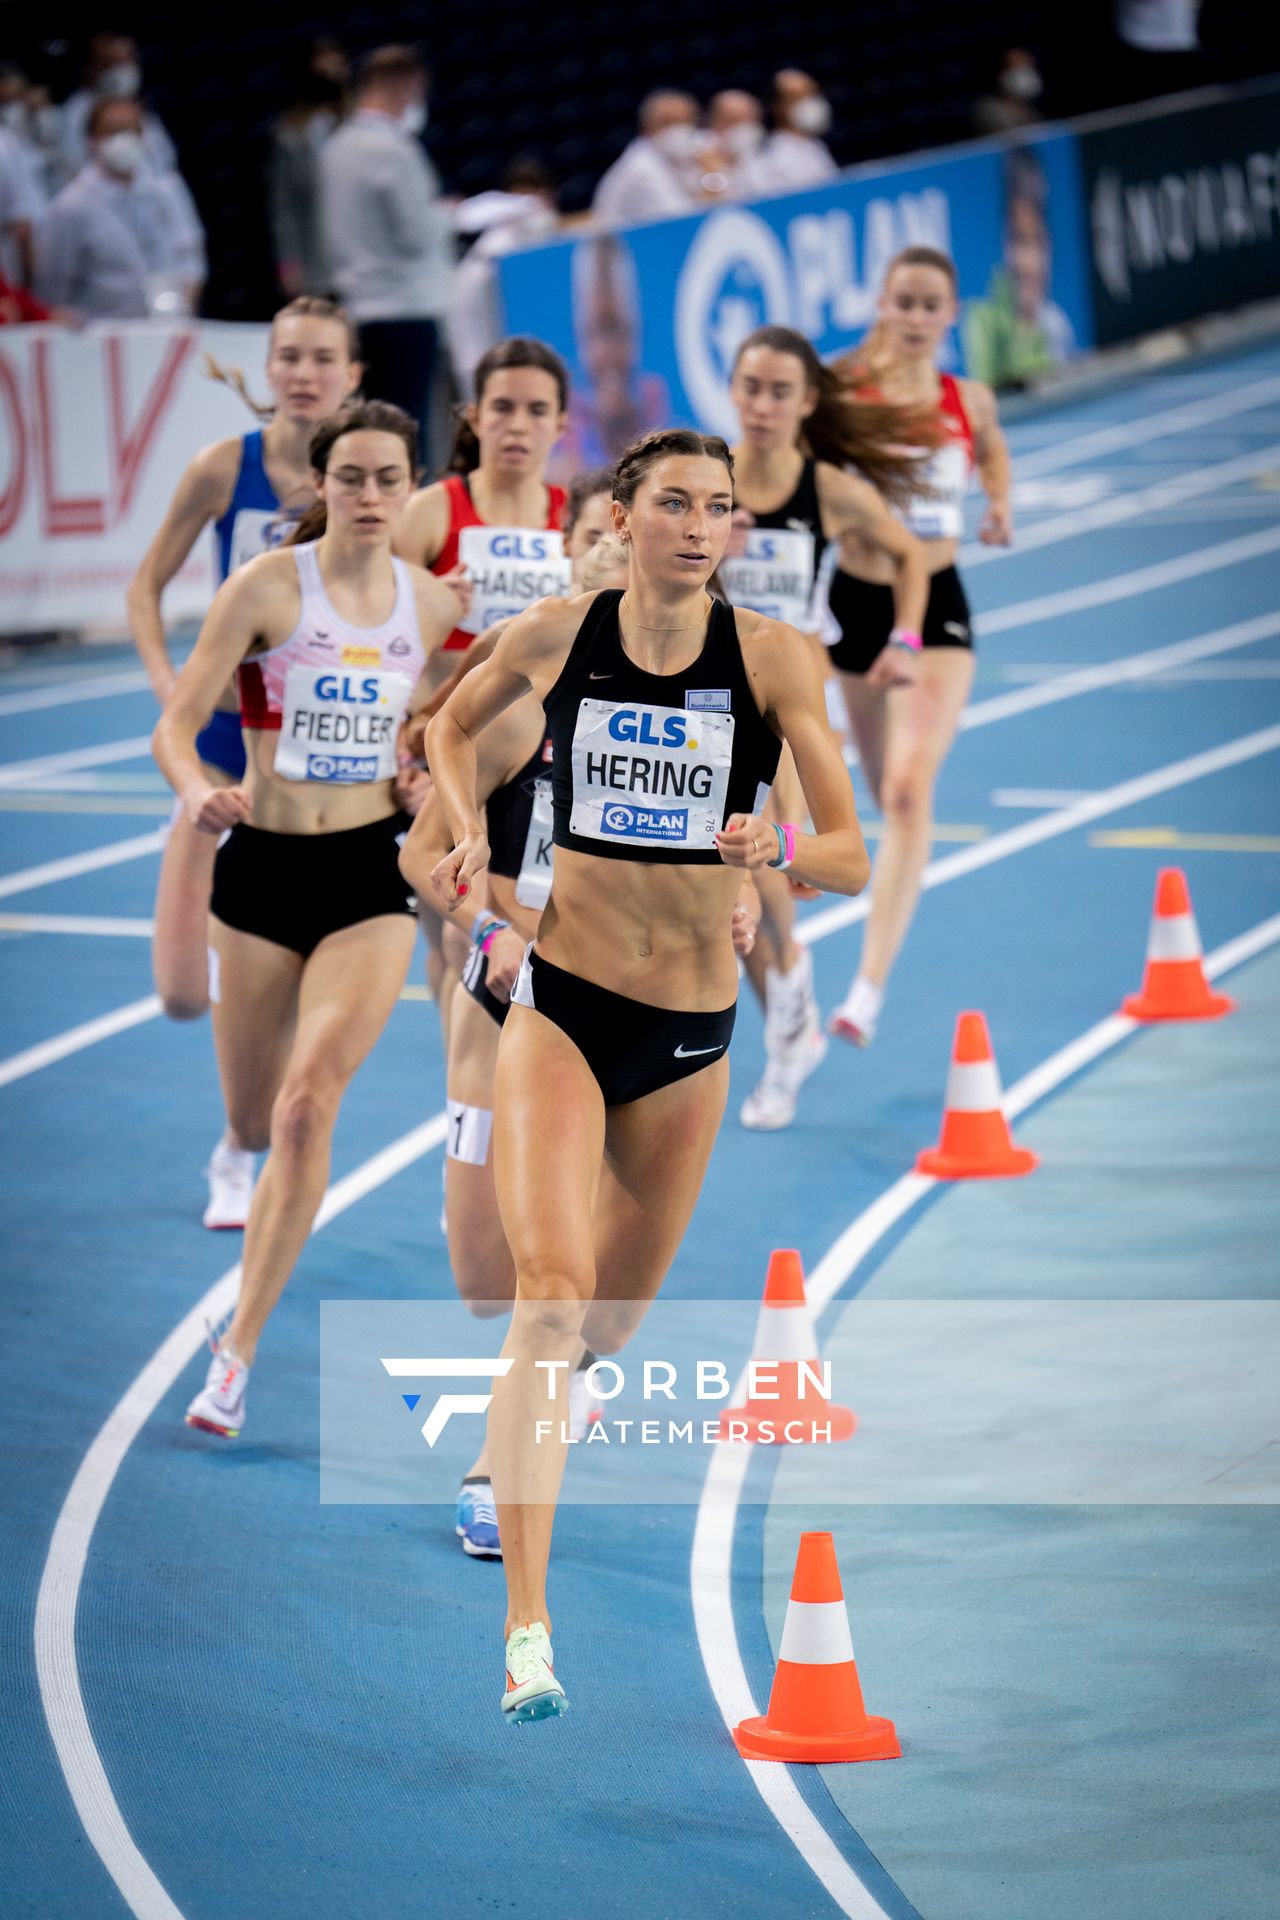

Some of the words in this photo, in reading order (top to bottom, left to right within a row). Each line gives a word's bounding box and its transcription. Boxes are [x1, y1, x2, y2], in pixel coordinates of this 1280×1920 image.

[292, 710, 393, 745] FIEDLER
[337, 758, 376, 774] PLAN
[586, 752, 713, 798] HERING
[636, 812, 684, 830] PLAN
[705, 818, 715, 833] 78
[635, 828, 684, 837] INTERNATIONAL
